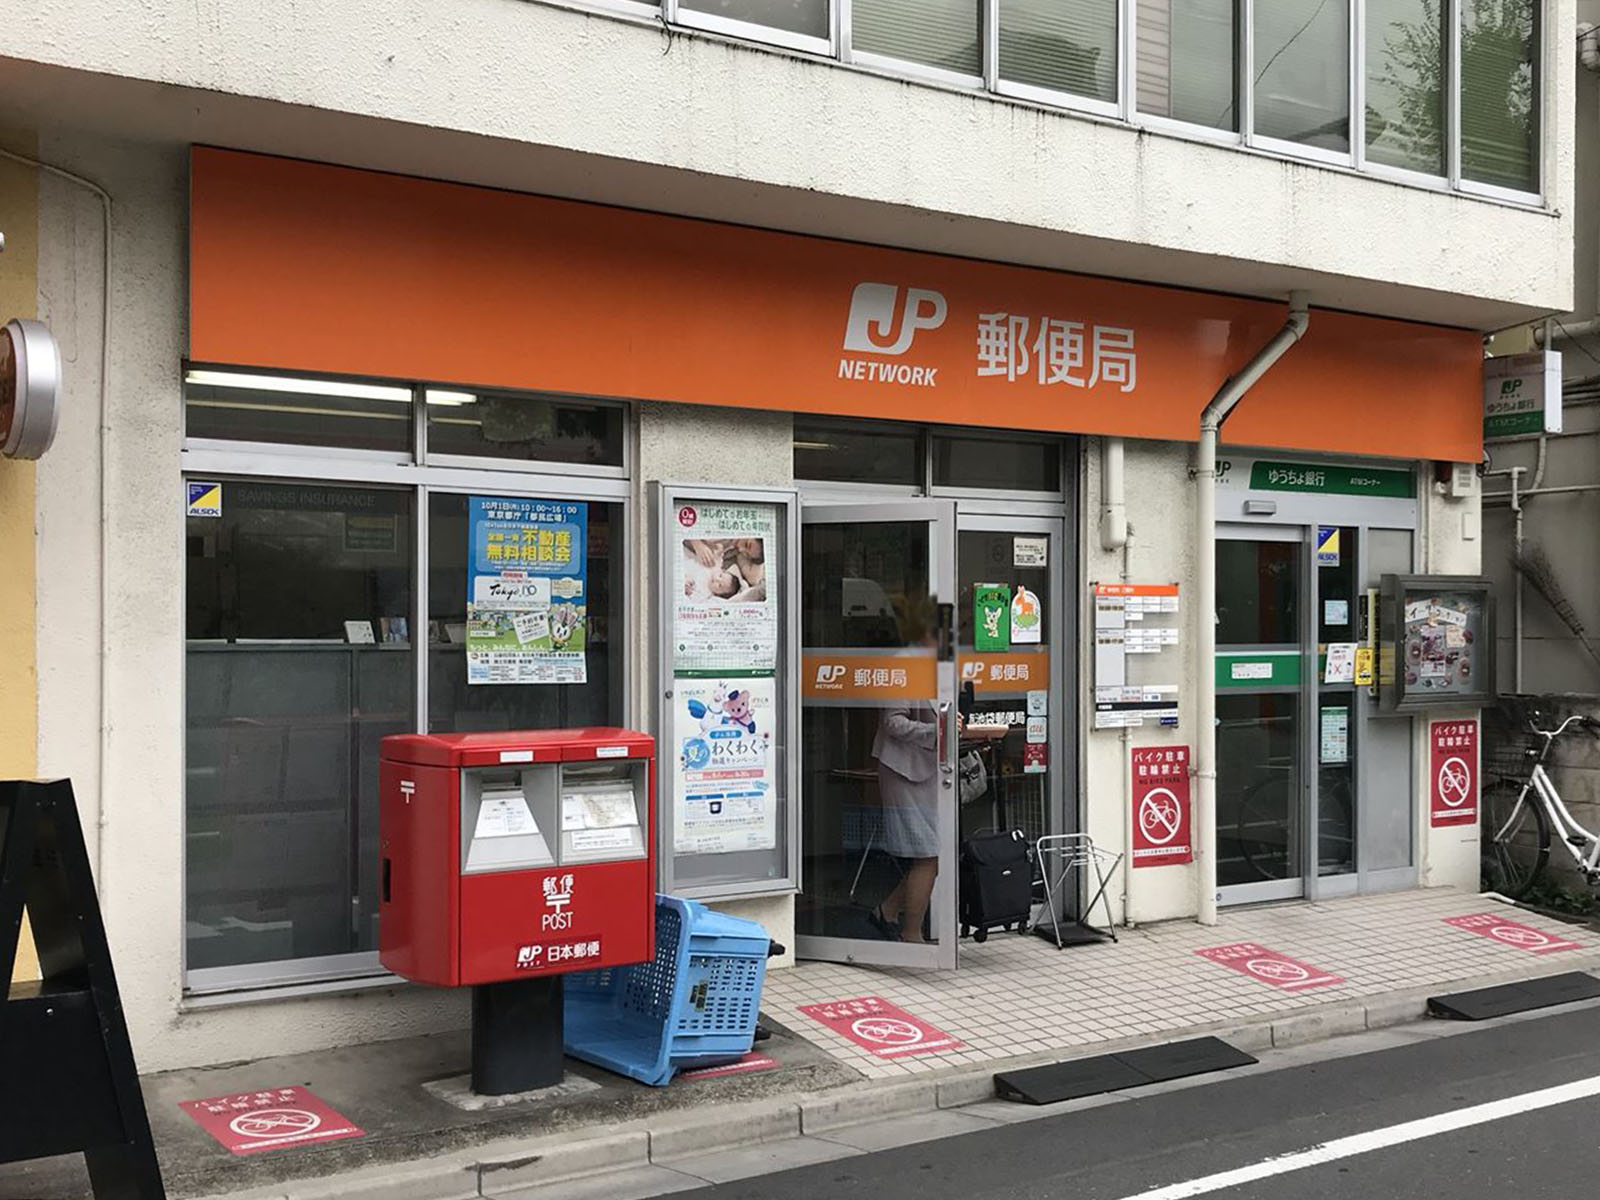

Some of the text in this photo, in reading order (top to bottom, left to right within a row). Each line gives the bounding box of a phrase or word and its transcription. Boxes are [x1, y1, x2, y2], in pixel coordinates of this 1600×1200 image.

[843, 282, 948, 355] JP
[976, 312, 1138, 392] 郵便局
[837, 359, 938, 387] NETWORK
[1268, 469, 1326, 488] ゆうちょ銀行
[238, 488, 377, 507] SAVINGS INSURANCE
[189, 507, 220, 516] ALSOK
[521, 527, 572, 547] 不動産
[486, 543, 572, 564] 無料相談会
[816, 664, 847, 683] JP
[854, 668, 907, 688] 郵便局
[962, 661, 985, 679] JP
[990, 664, 1030, 682] 郵便局
[711, 740, 758, 757] わくわく
[1134, 750, 1186, 764] バイク駐車
[1138, 764, 1182, 777] 駐輪禁止
[543, 874, 574, 897] 郵便
[542, 911, 574, 932] POST
[518, 940, 600, 962] JP 日本郵便
